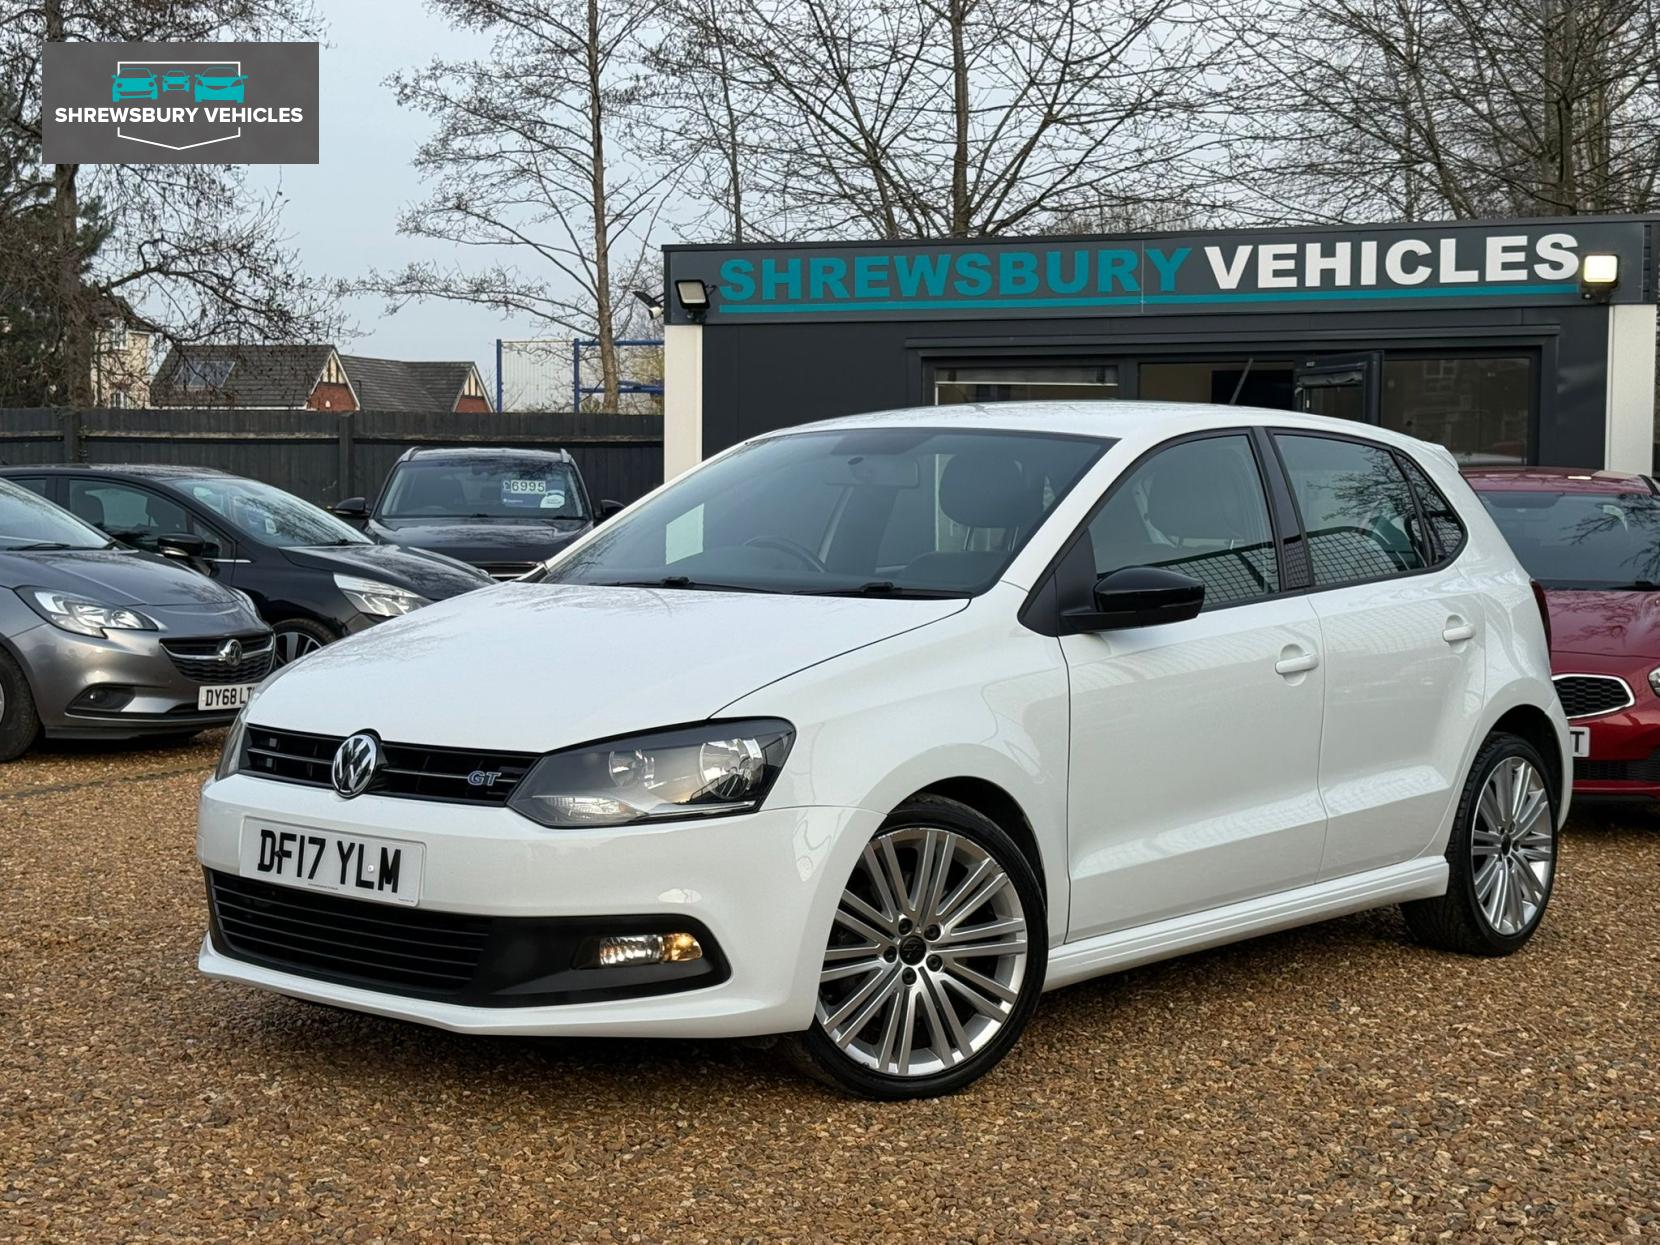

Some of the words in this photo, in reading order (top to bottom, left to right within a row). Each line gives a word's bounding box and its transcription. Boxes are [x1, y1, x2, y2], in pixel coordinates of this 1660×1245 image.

[719, 247, 1193, 301] SHREWSBURY
[1204, 233, 1579, 290] VEHICLES
[205, 688, 237, 706] DY68
[467, 770, 501, 786] GT
[257, 829, 326, 880] DF17
[337, 840, 402, 893] YLM
